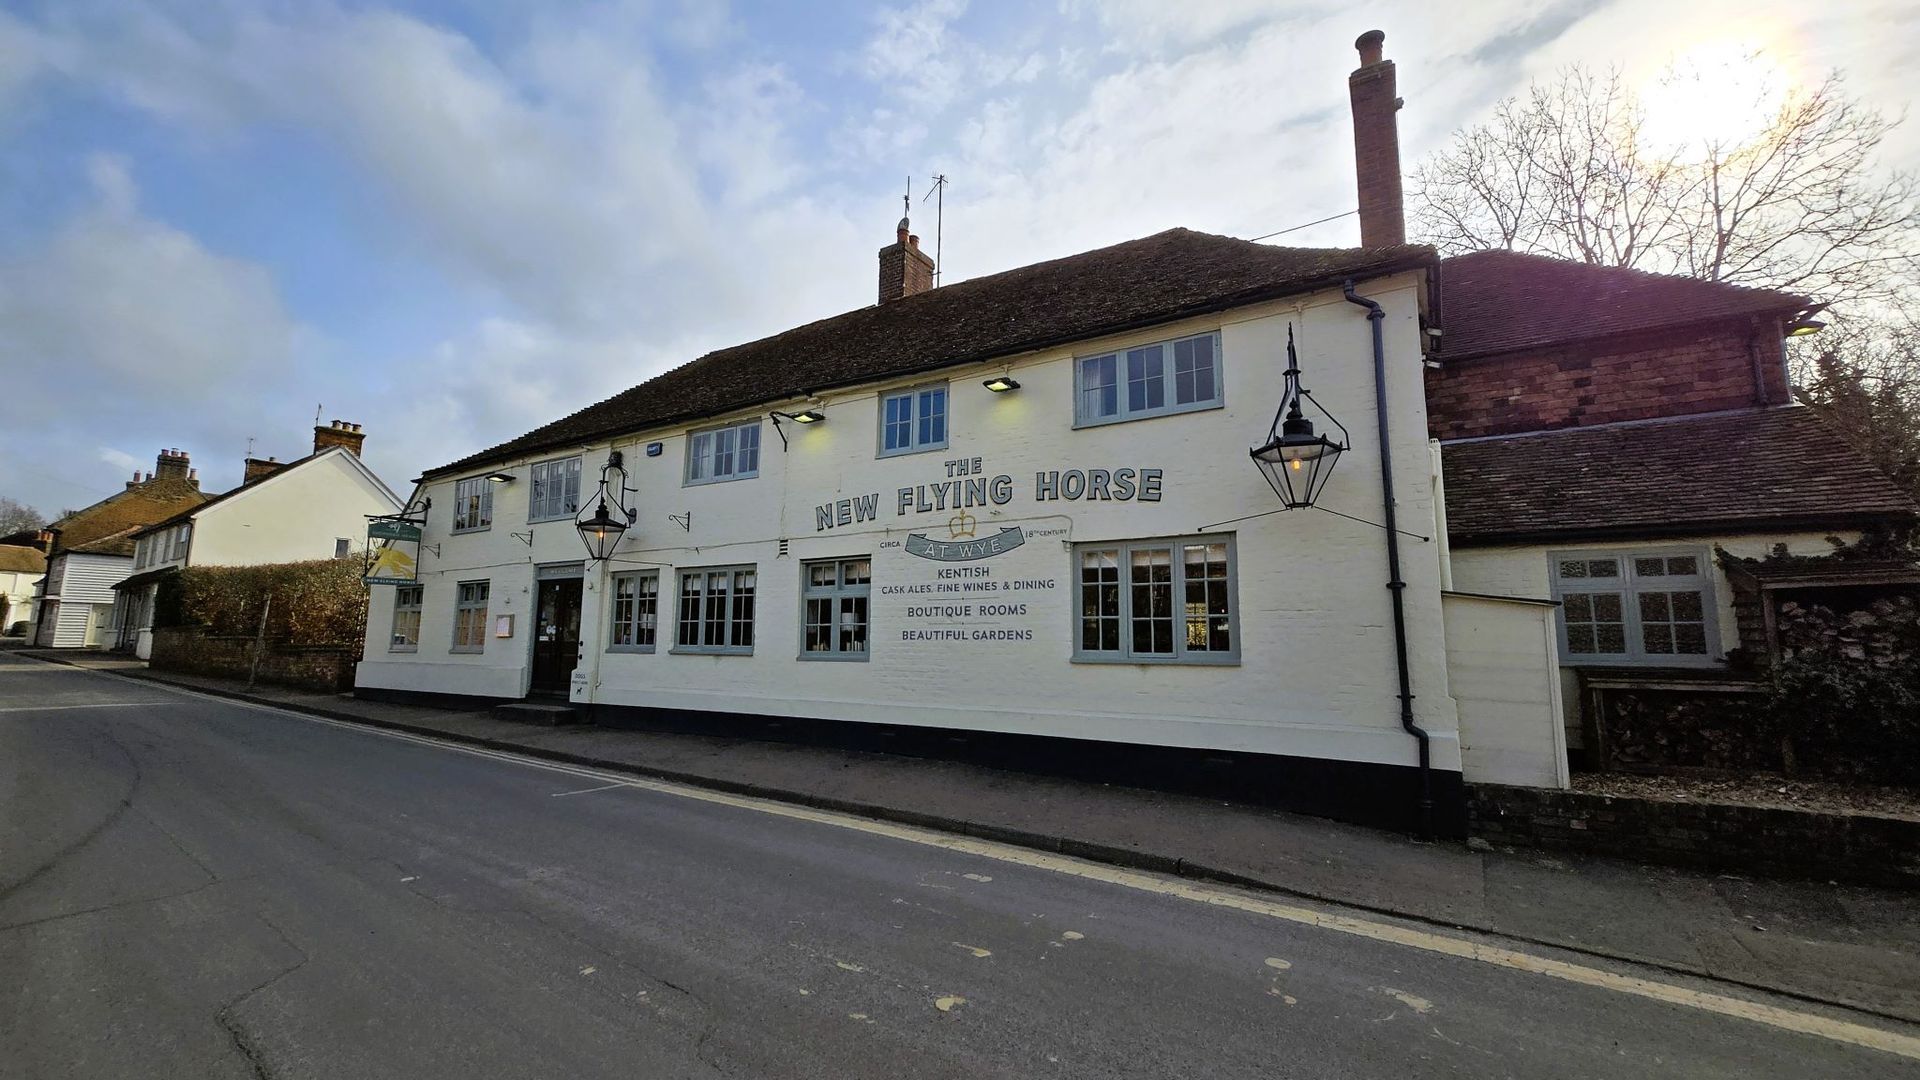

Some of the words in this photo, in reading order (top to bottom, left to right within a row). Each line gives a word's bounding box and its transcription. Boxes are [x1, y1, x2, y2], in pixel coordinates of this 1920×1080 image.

[944, 456, 982, 477] THE
[815, 492, 880, 531] NEW
[897, 474, 1013, 516] FLYING
[1035, 468, 1163, 503] HORSE
[1039, 528, 1067, 537] CENTURY
[879, 541, 901, 549] CIRCA
[924, 543, 949, 558] AT
[960, 537, 1002, 558] WYE
[937, 566, 990, 579] KENTISH
[881, 585, 905, 595] CASK
[937, 583, 960, 593] FINE
[963, 581, 998, 592] WINES
[1002, 581, 1011, 590] &
[1013, 579, 1055, 590] DINING
[907, 605, 972, 618] BOUTIQUE
[979, 604, 1027, 616] ROOMS
[902, 630, 968, 641] BEAUTIFUL
[972, 629, 1033, 640] GARDENS
